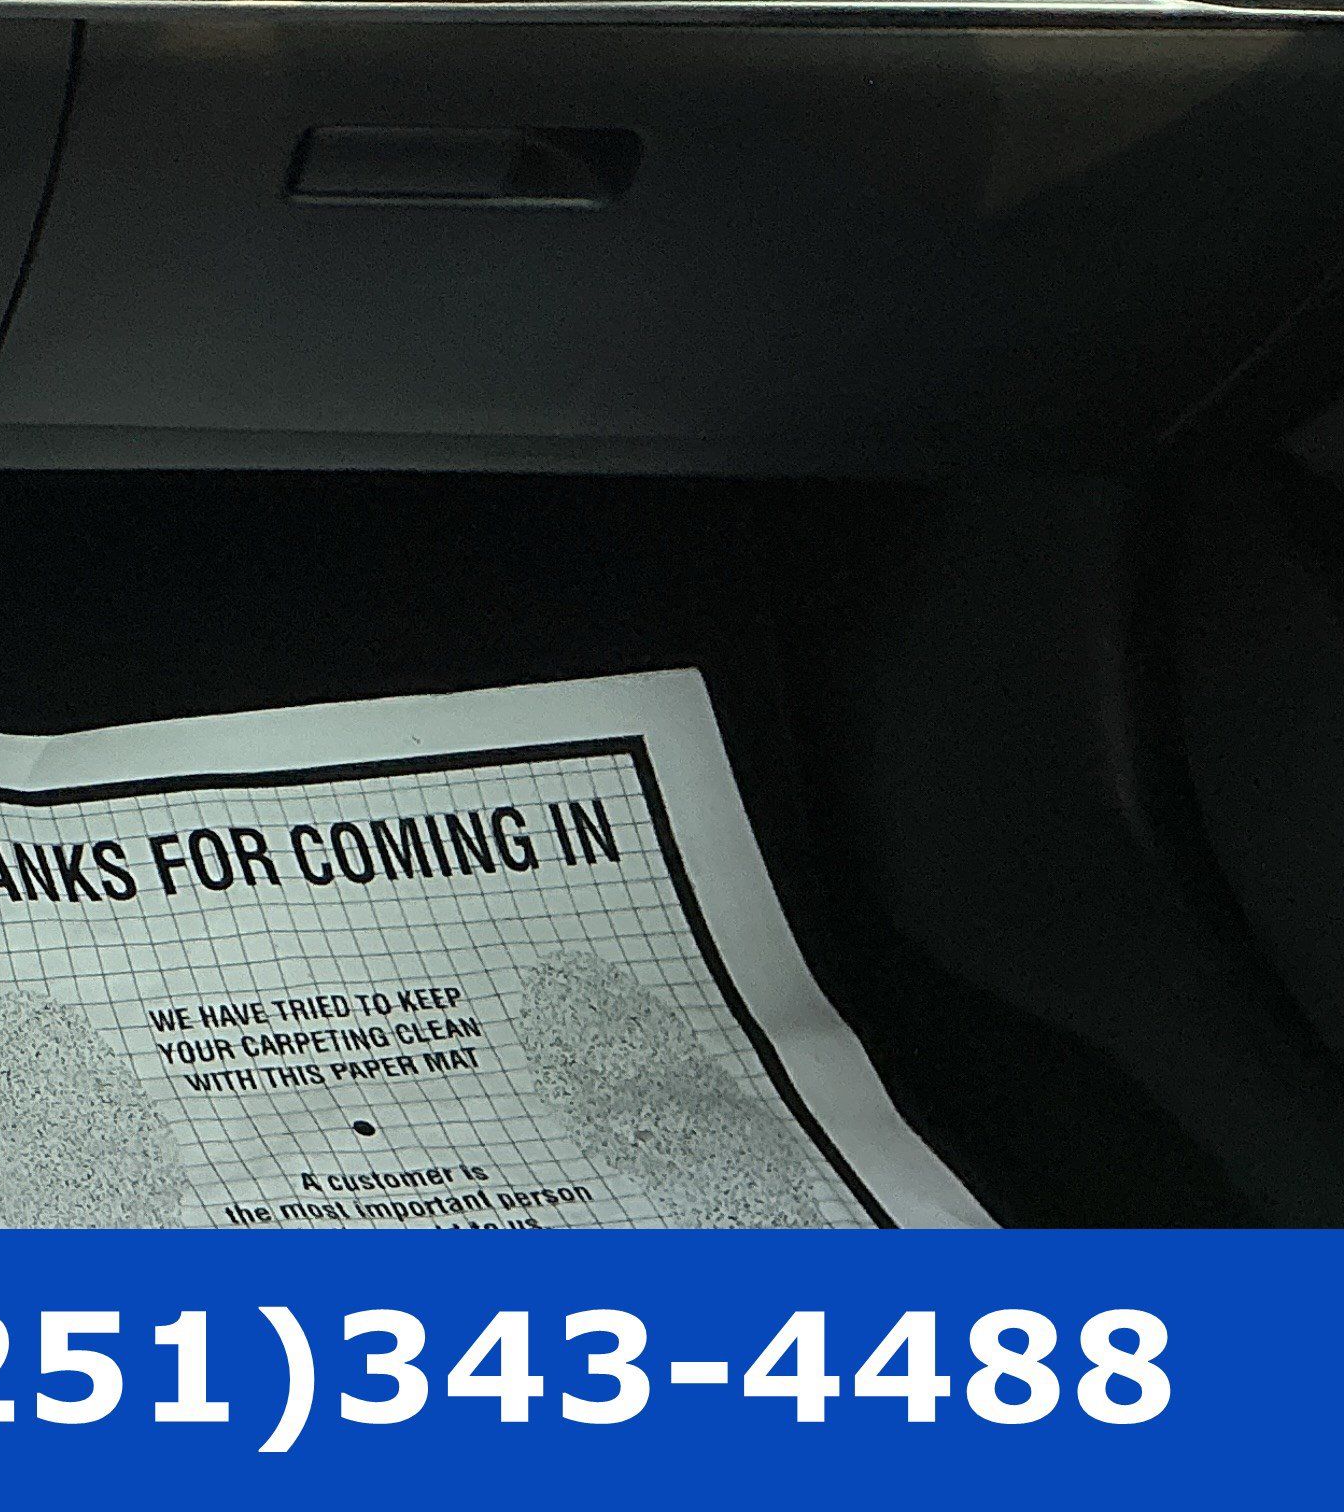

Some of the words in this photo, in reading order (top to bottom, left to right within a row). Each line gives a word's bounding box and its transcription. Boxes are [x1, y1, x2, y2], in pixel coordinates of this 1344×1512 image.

[149, 827, 283, 896] FOR
[292, 805, 541, 886] COMING
[548, 798, 622, 867] IN
[149, 1007, 193, 1034] WE
[199, 1000, 268, 1030] HAVE
[272, 993, 352, 1023] TRIED
[354, 992, 394, 1017] TO
[398, 986, 463, 1014] KEEP
[158, 1038, 234, 1065] YOUR
[242, 1027, 390, 1058] CARPETING
[397, 1017, 484, 1046] CLEAN
[186, 1068, 258, 1093] WITH
[261, 1064, 326, 1089] THIS
[333, 1056, 420, 1081] PAPER
[423, 1046, 484, 1073] MAT
[300, 1171, 322, 1192] A
[328, 1164, 455, 1192] customer
[461, 1164, 490, 1182] is
[225, 1203, 272, 1227] the
[279, 1196, 350, 1223] most
[355, 1189, 492, 1224] important
[497, 1183, 594, 1212] person
